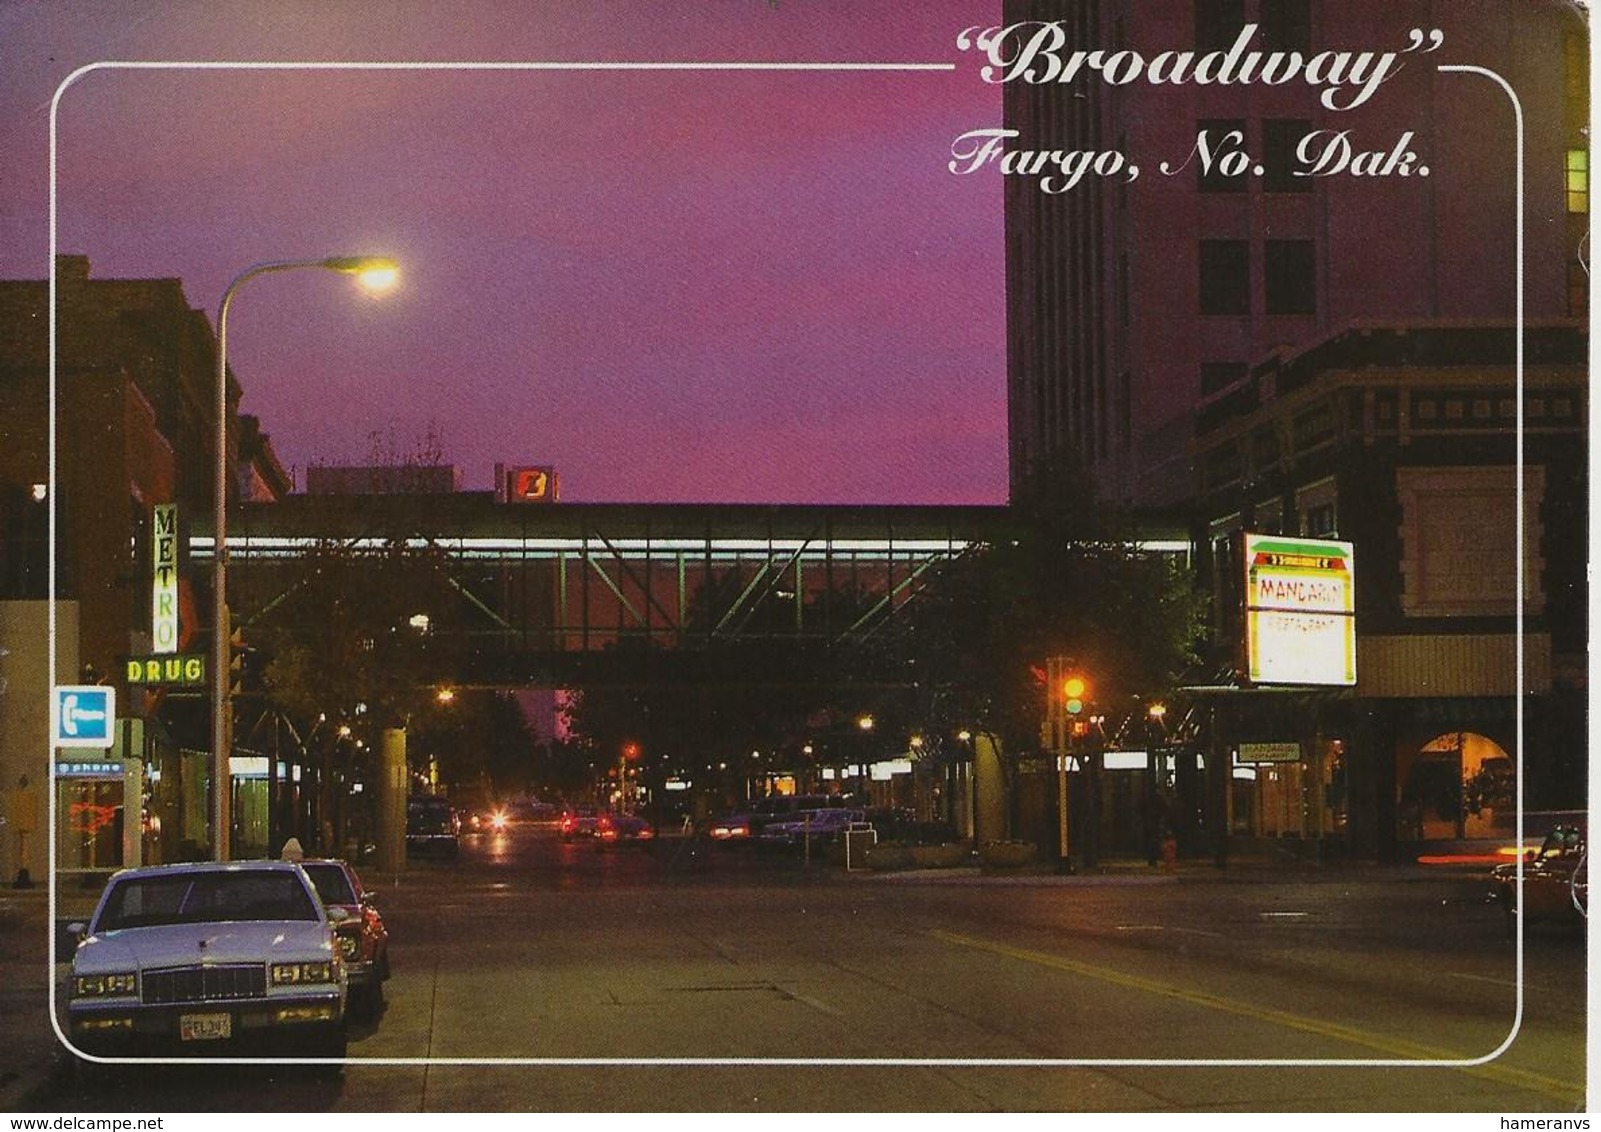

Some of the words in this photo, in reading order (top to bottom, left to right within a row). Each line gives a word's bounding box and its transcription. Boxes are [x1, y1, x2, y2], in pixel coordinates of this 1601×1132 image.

[155, 508, 175, 646] METRO
[127, 659, 201, 683] DRUG
[73, 763, 120, 772] phone
